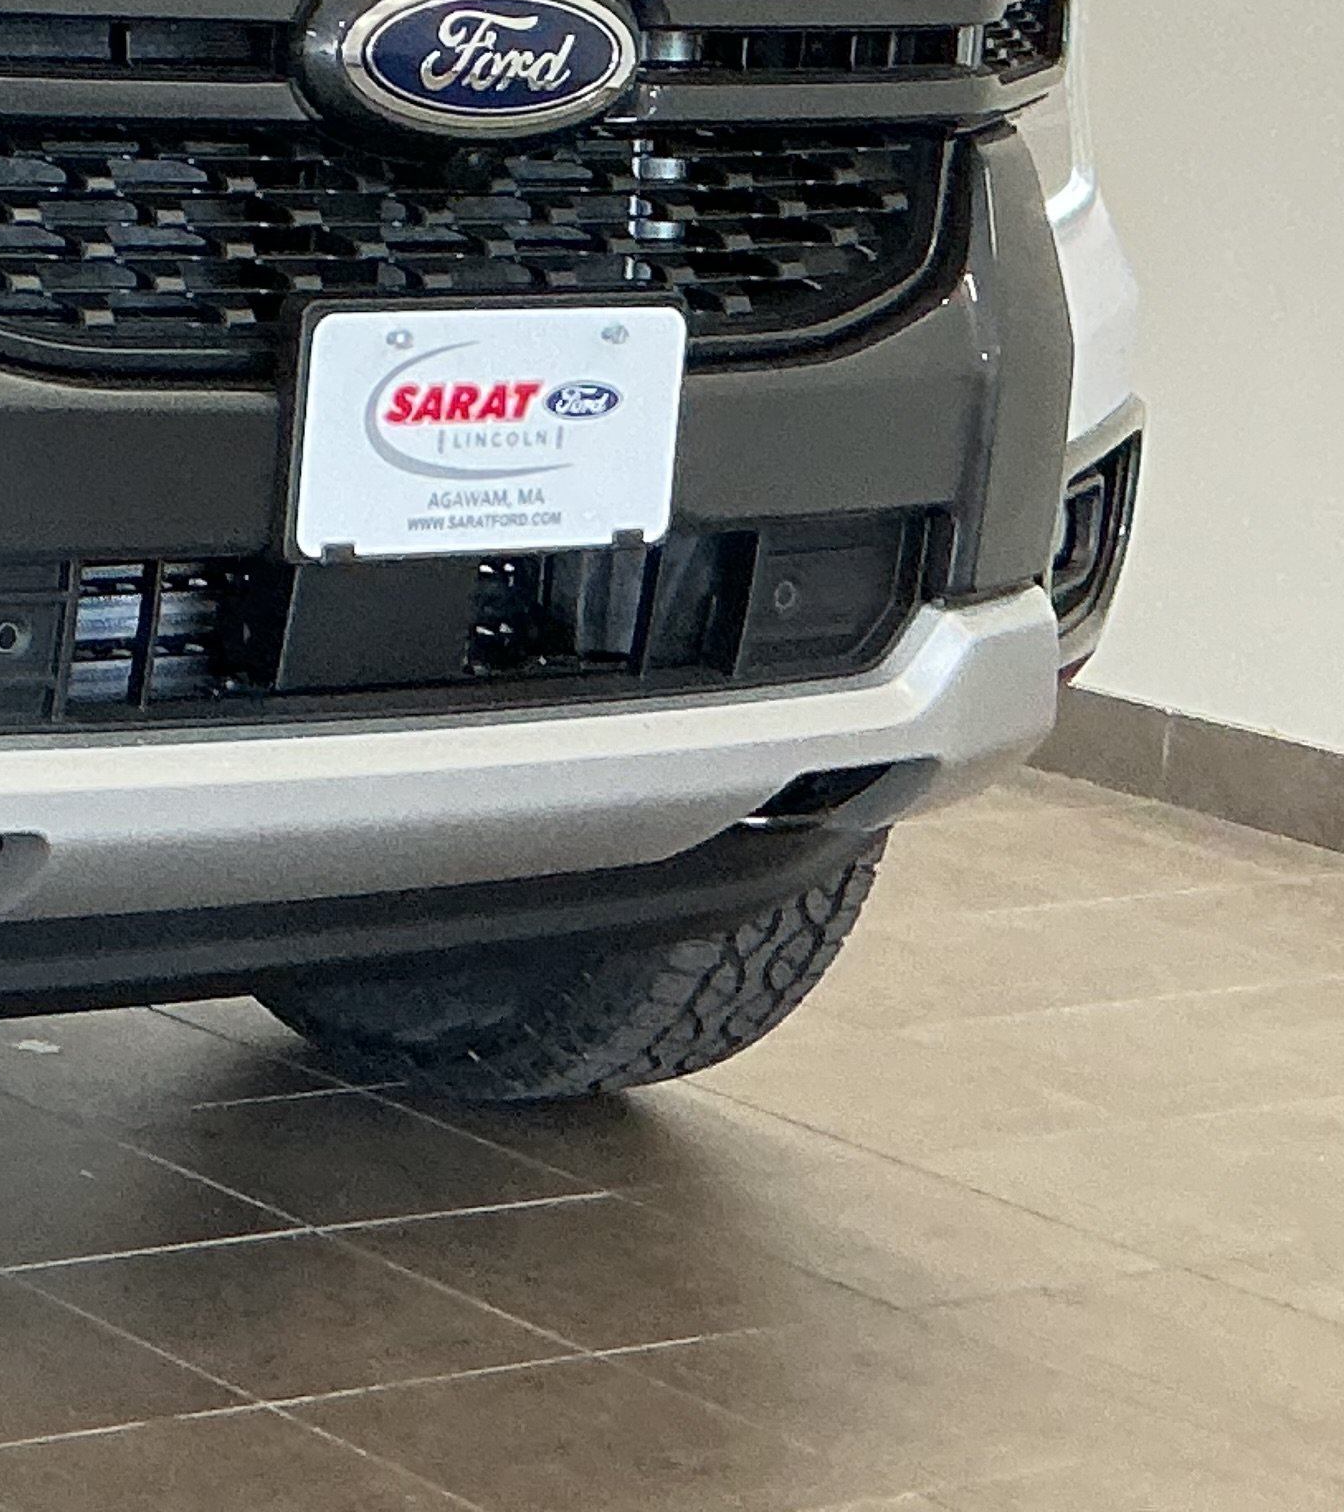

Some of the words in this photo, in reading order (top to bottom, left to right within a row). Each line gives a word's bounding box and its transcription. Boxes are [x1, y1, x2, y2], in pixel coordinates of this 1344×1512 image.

[419, 8, 576, 91] Ford
[386, 382, 541, 424] SARAT
[554, 386, 611, 415] Ford
[452, 430, 549, 449] LINCOLN
[427, 490, 513, 510] AGAWAM,
[517, 488, 545, 504] MA
[407, 511, 562, 530] WWW.SARATFORD.COM
